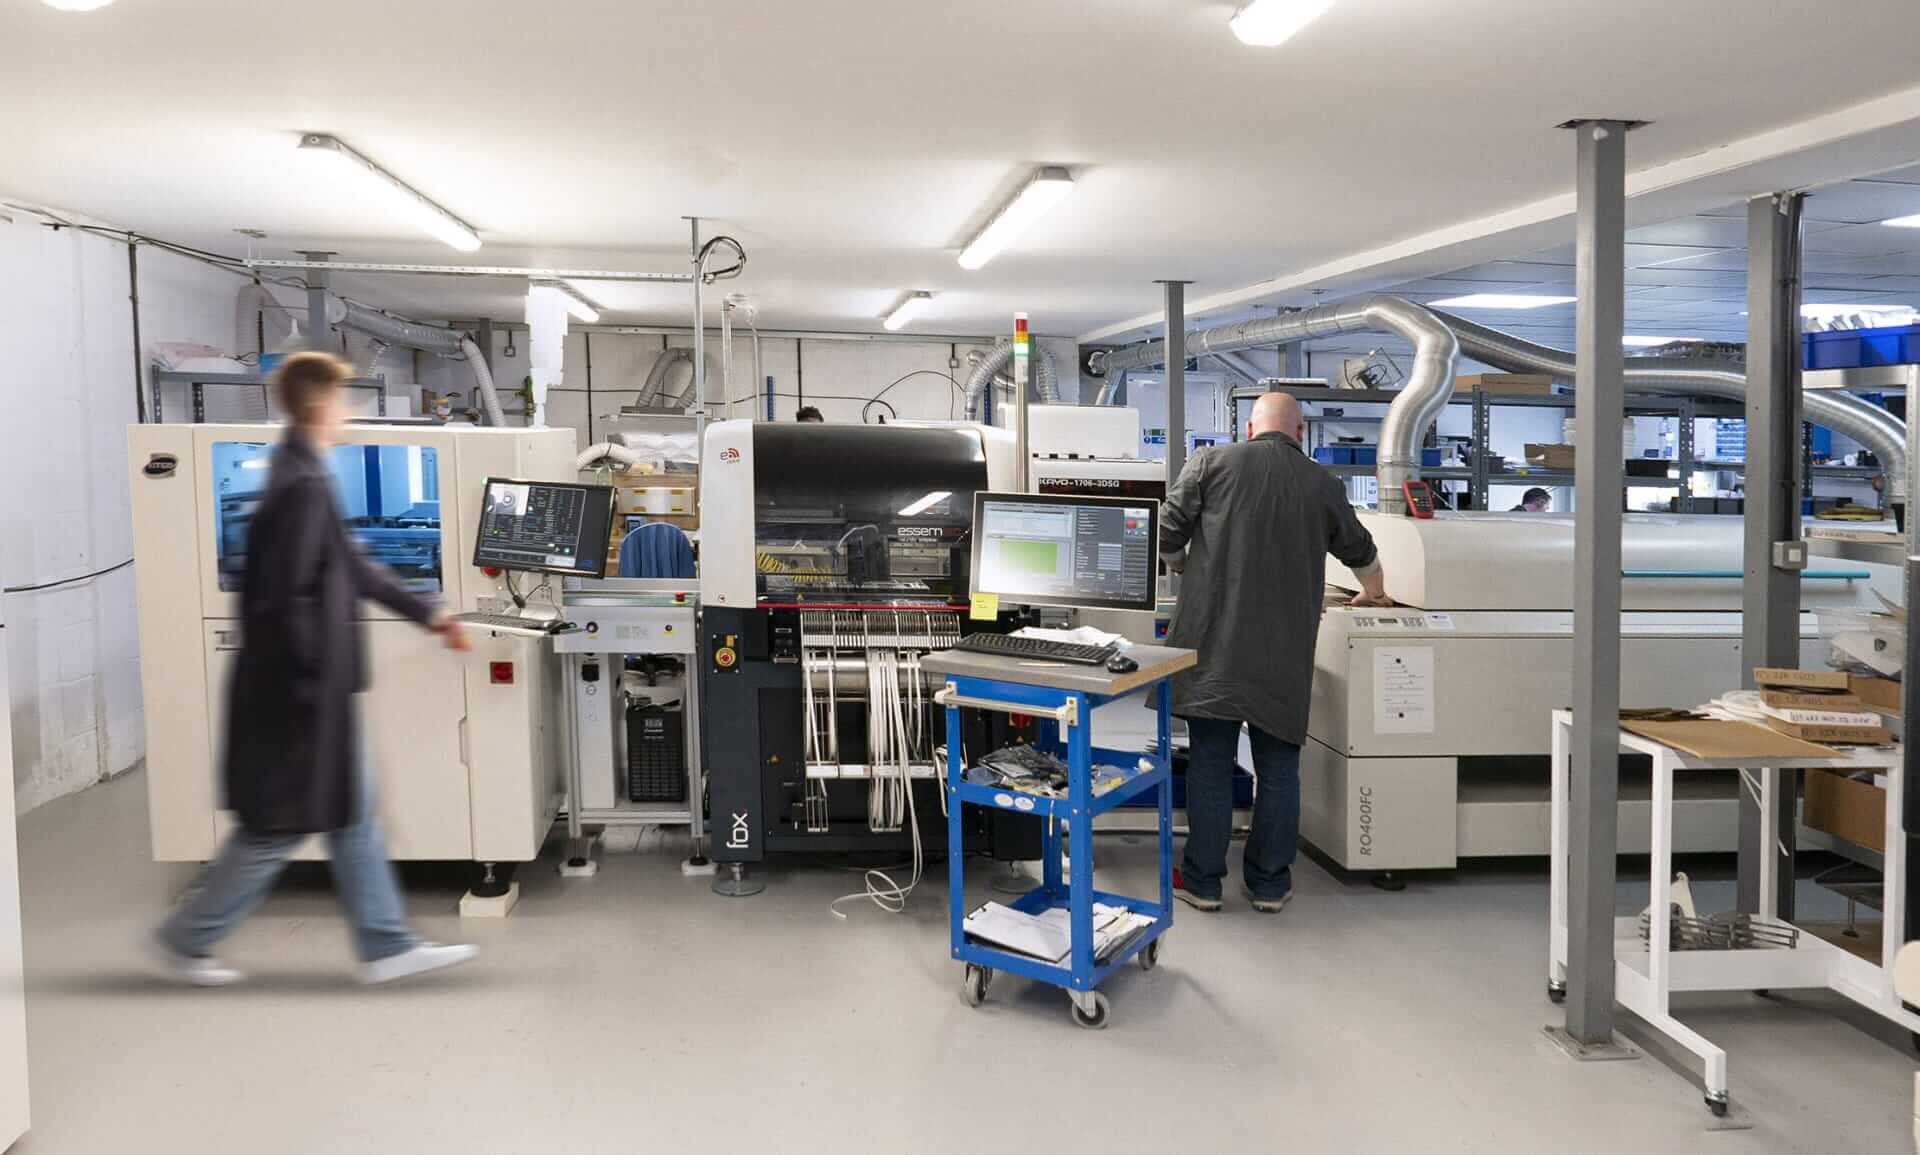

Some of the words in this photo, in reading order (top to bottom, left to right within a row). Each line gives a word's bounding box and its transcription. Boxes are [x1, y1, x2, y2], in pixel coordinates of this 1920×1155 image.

[897, 526, 962, 537] essem
[726, 813, 749, 848] fox
[1360, 786, 1372, 856] RO400FC
